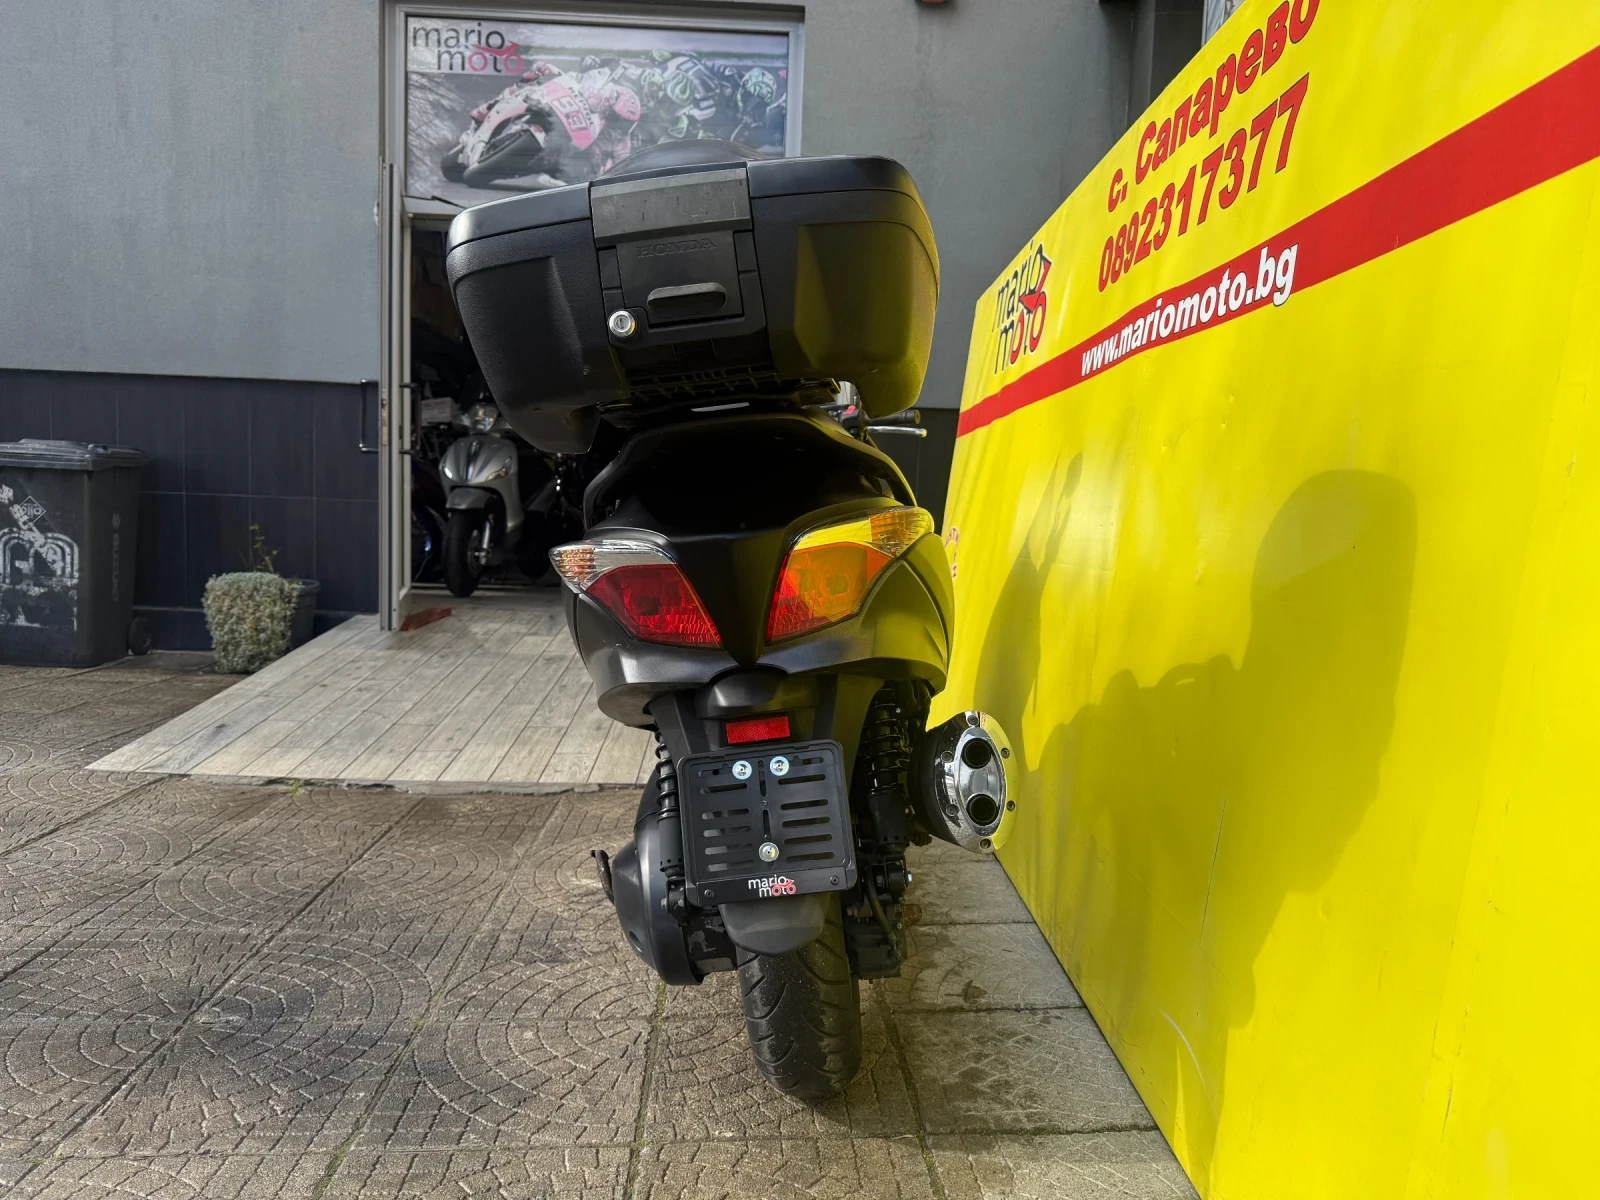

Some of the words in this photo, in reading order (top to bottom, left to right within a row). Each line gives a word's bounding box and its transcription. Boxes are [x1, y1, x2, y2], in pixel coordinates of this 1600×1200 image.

[412, 22, 505, 50] mario
[436, 49, 524, 74] moto
[1135, 0, 1320, 185] Сапарево
[1098, 72, 1309, 292] 0892317377
[636, 237, 717, 258] HONDA
[991, 239, 1043, 333] mario
[1081, 242, 1299, 377] www.mariomoto.bg
[995, 291, 1047, 375] moto
[748, 874, 787, 889] mario
[759, 884, 797, 897] moto
